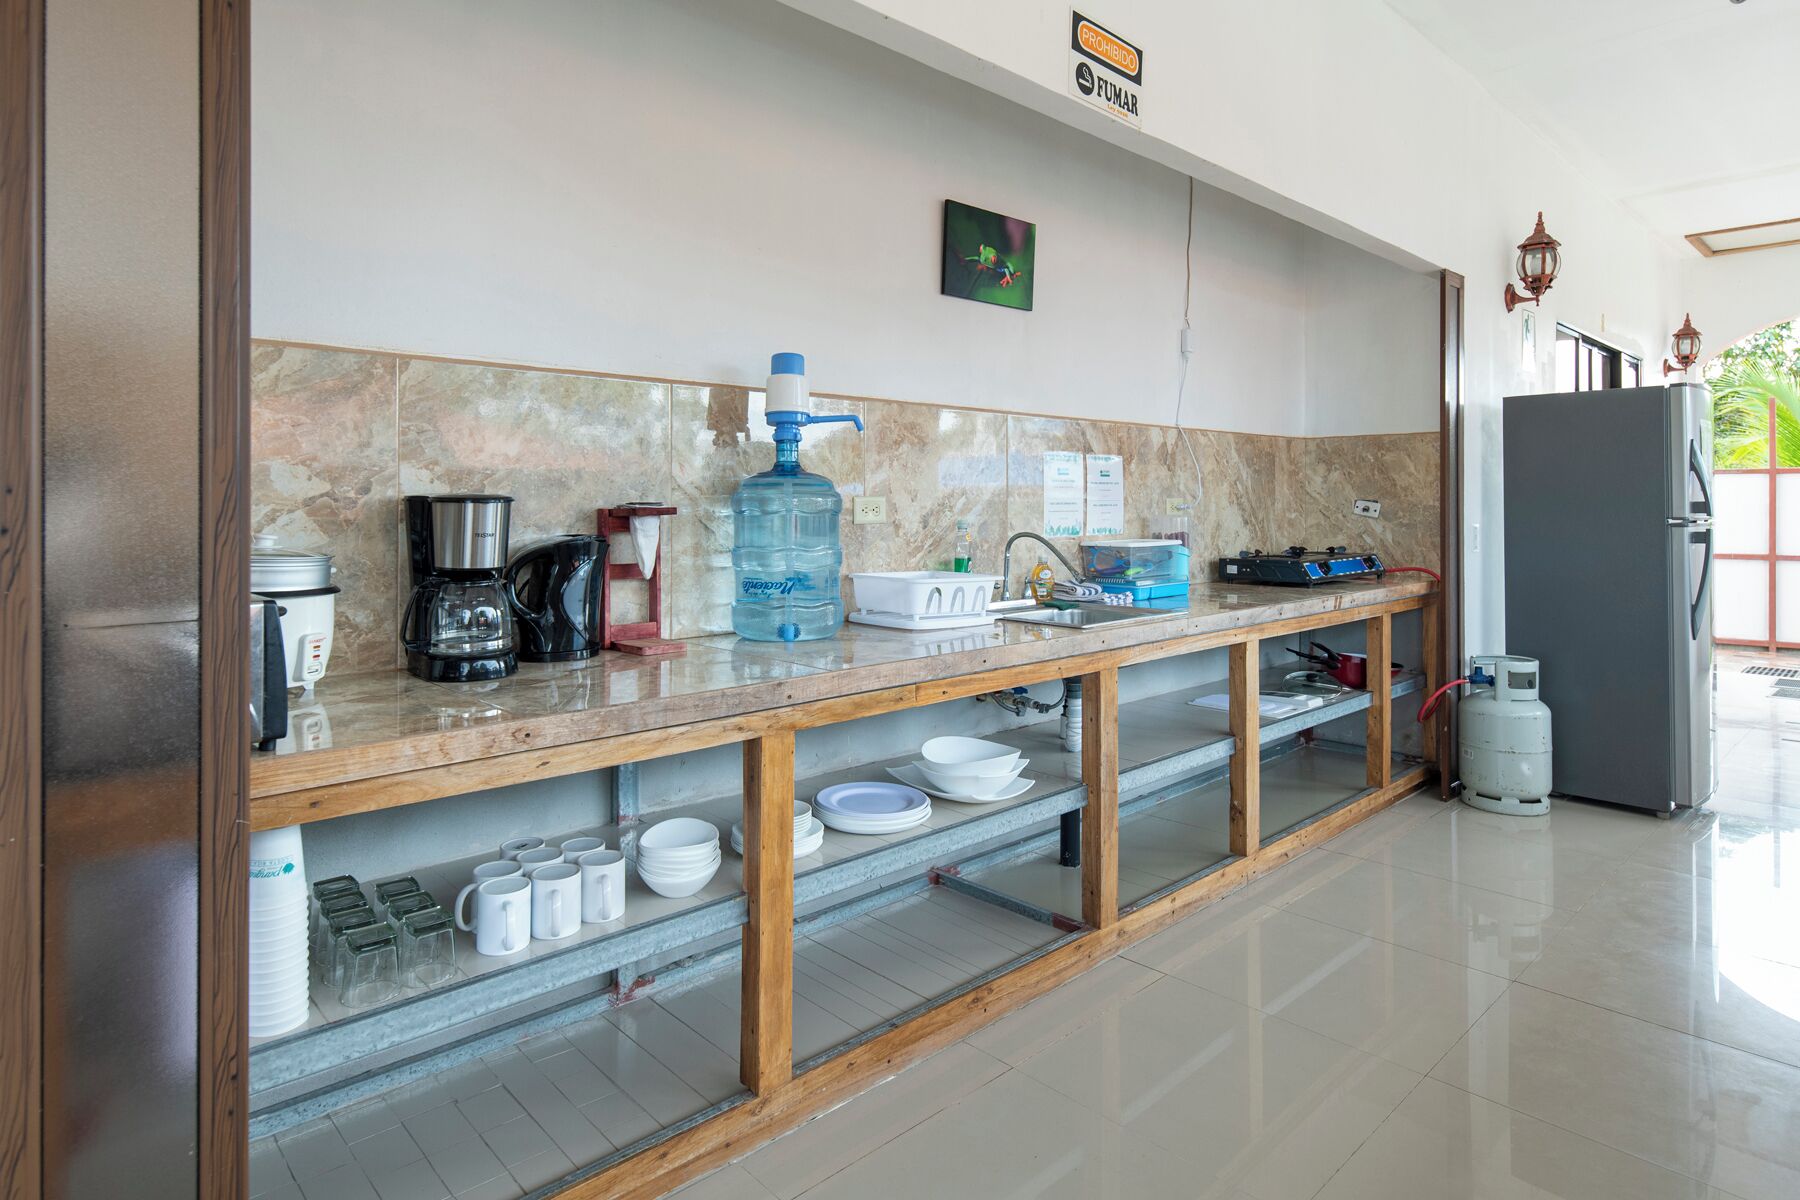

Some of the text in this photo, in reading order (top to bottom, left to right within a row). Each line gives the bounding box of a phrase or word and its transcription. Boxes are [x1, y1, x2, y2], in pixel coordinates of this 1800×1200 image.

[1082, 28, 1136, 69] PROHIBIDO
[1097, 75, 1138, 117] FUMAR
[743, 579, 796, 595] Naciente
